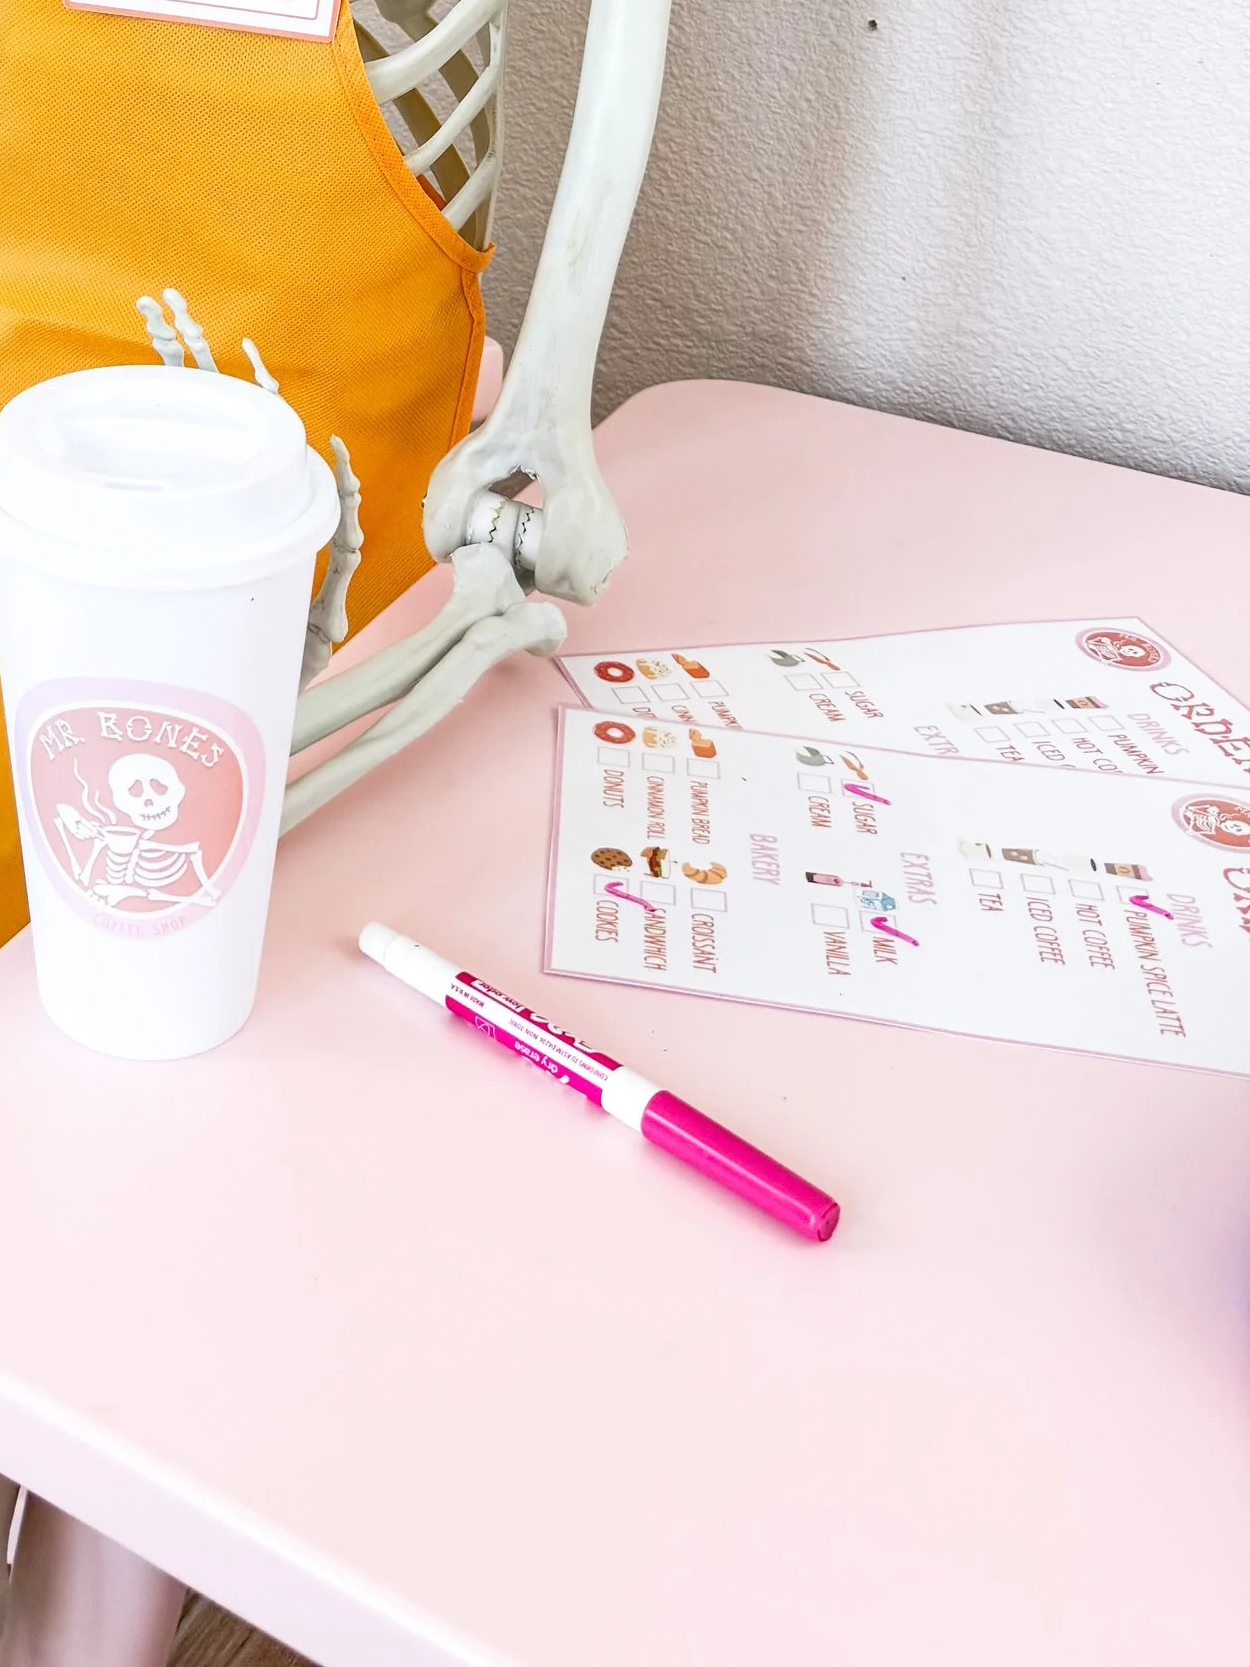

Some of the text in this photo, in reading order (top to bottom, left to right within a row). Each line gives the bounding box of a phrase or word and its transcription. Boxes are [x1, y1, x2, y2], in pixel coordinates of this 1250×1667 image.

[808, 693, 847, 723] CREAM
[844, 689, 884, 720] SUGAR
[39, 711, 224, 768] MR BONES
[913, 724, 960, 756] EXTR
[995, 744, 1026, 764] TEA
[1032, 740, 1066, 763] ICED
[1071, 736, 1102, 757] HOT
[1107, 734, 1164, 775] PUMPKIN
[1126, 713, 1190, 756] DRINKS
[603, 769, 625, 809] DONUTS
[646, 776, 666, 840] CINNAMON ROLL
[690, 780, 711, 845] PUMPKIN BREAD
[808, 795, 832, 828] CREAM
[852, 800, 878, 835] SUGAR
[749, 833, 782, 886] BAKERY
[900, 852, 938, 905] EXTRAS
[595, 899, 619, 943] COOKIES
[978, 892, 1005, 912] TEA
[1166, 893, 1214, 949] DRINKS
[152, 915, 187, 936] SHOP
[691, 913, 717, 973] CROISSANT
[1025, 896, 1066, 966] ICED COFFEE
[1075, 902, 1116, 970] HOT COFFEE
[823, 930, 852, 976] VANILLA
[872, 936, 899, 965] MILK
[1122, 909, 1187, 1038] PUMPKIN SPICE LATTE
[514, 1040, 559, 1074] dry erase
